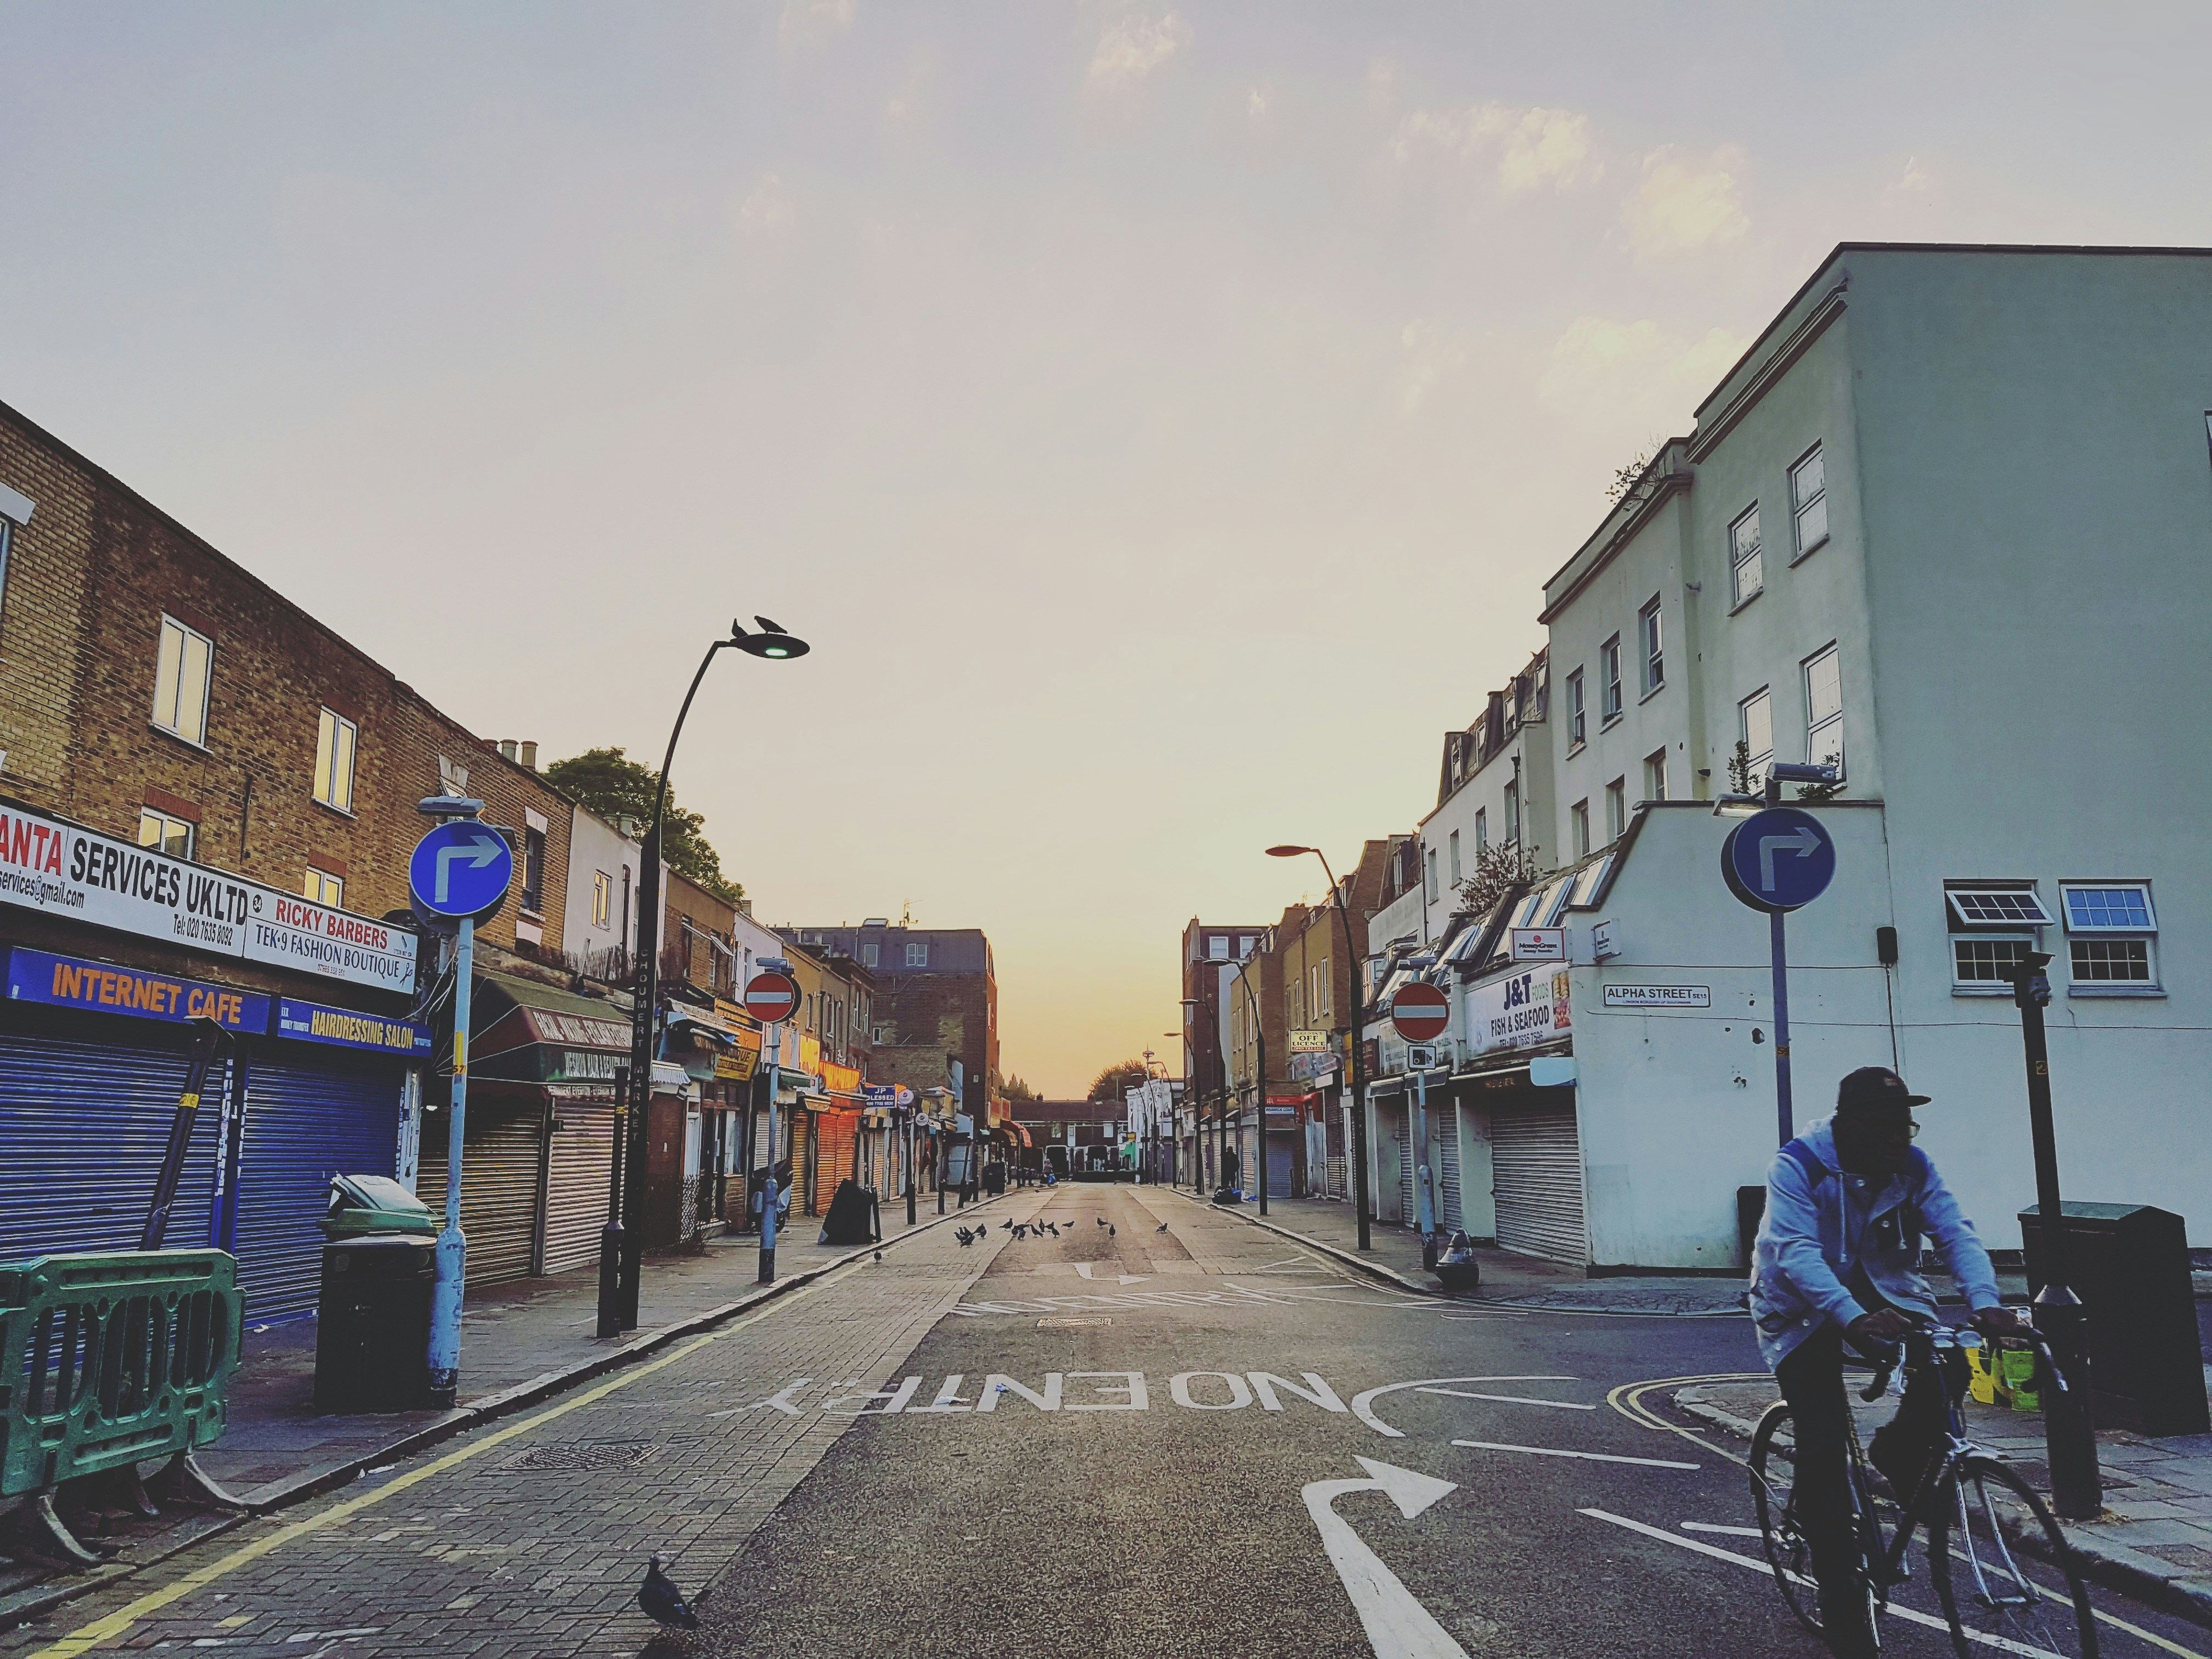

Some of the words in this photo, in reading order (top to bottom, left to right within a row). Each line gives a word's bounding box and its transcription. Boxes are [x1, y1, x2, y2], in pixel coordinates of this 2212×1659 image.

[71, 838, 180, 907] SERVICES
[253, 897, 262, 910] 34
[276, 899, 323, 932] RICKY
[326, 915, 388, 949] BARBERS
[173, 913, 185, 936] Tel:
[187, 917, 199, 939] 020
[201, 921, 217, 943] 7635
[291, 934, 342, 964] FASHION
[344, 948, 399, 979] BOUTIQUE
[52, 963, 182, 1014] INTERNET
[188, 988, 242, 1024] CAFE
[636, 949, 648, 1047] CHOUMERT
[1504, 973, 1531, 1011] J&T
[1607, 988, 1646, 998] ALPHA
[1649, 989, 1692, 998] STREET
[311, 1010, 383, 1045] HAIRDRESSING
[385, 1024, 413, 1049] SALON
[1491, 1017, 1506, 1037] FISH
[1508, 1015, 1513, 1033] &
[1514, 1005, 1549, 1031] SEAFOOD
[632, 1065, 643, 1142] MARKET
[705, 1371, 1149, 1415] ENTRY
[1170, 1371, 1350, 1413] NO
